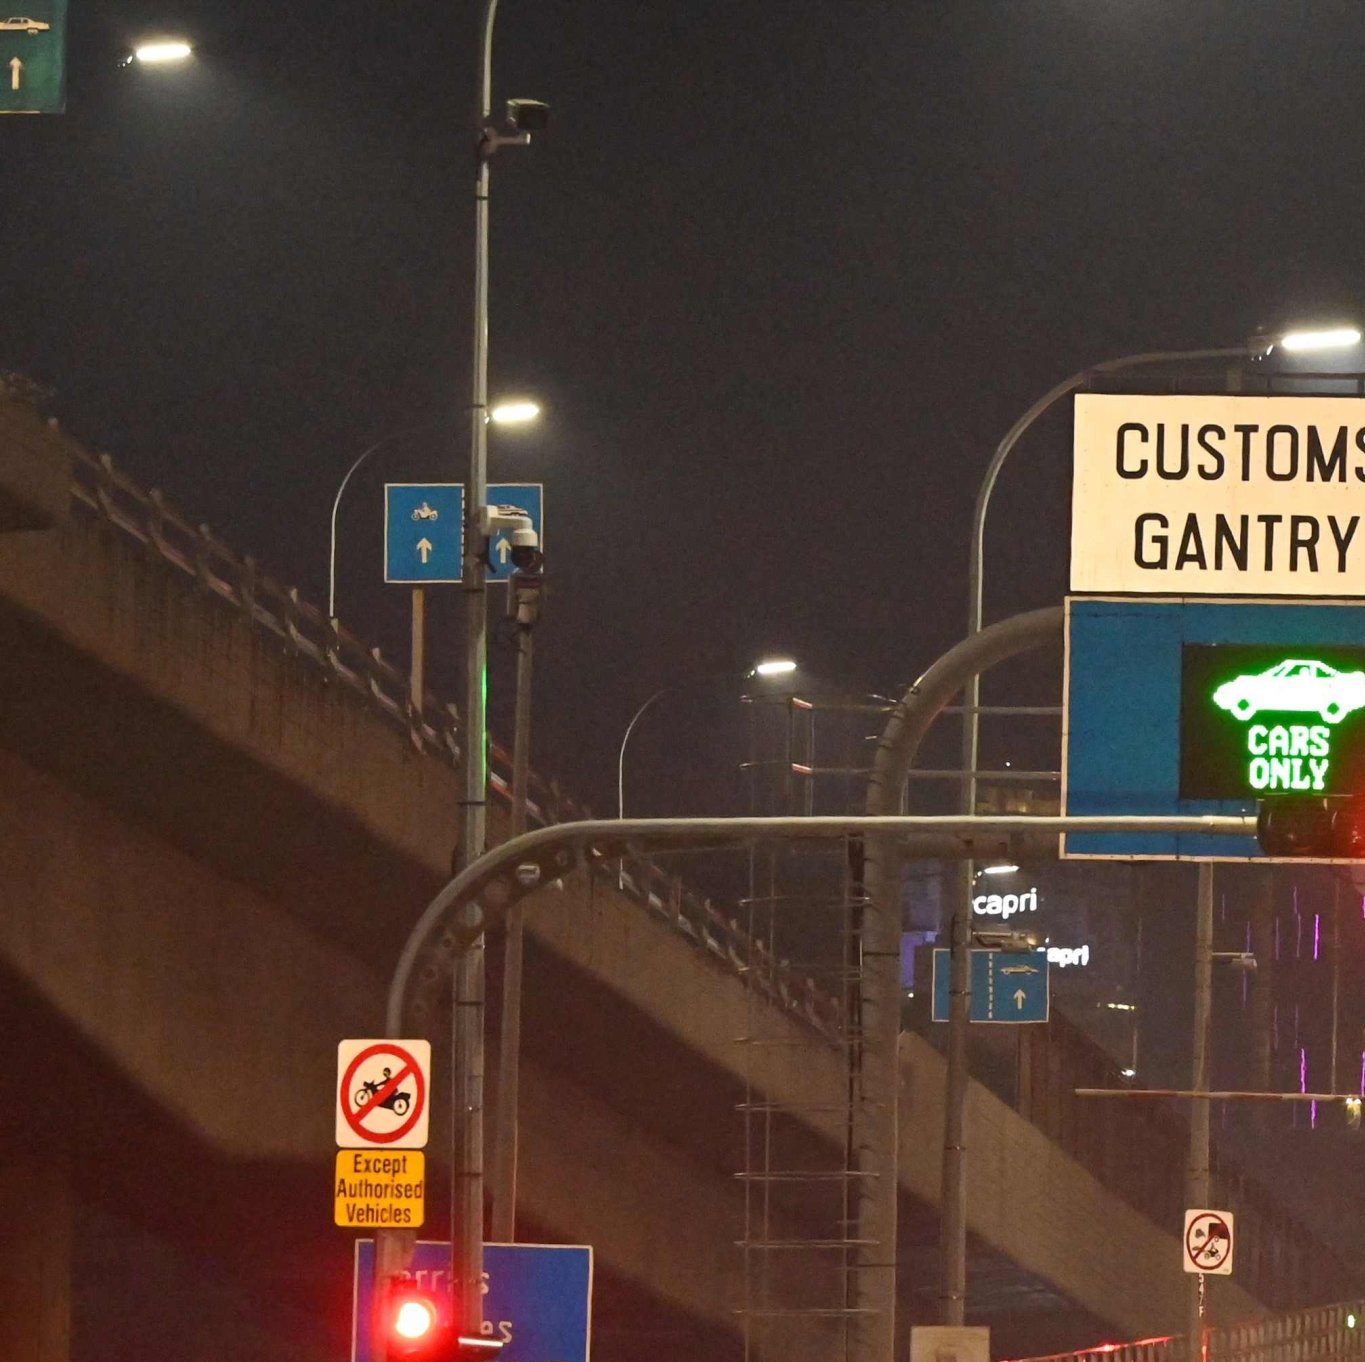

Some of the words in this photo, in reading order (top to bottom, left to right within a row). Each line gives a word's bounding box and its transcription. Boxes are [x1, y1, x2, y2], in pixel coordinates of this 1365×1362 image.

[1134, 512, 1361, 573] GANTRY
[1247, 725, 1331, 756] CARS
[1248, 758, 1329, 791] ONLY
[972, 887, 1037, 919] capri
[1037, 944, 1090, 968] apri
[353, 1153, 407, 1177] Except
[336, 1178, 424, 1200] Authorised
[345, 1203, 411, 1224] Vehicles
